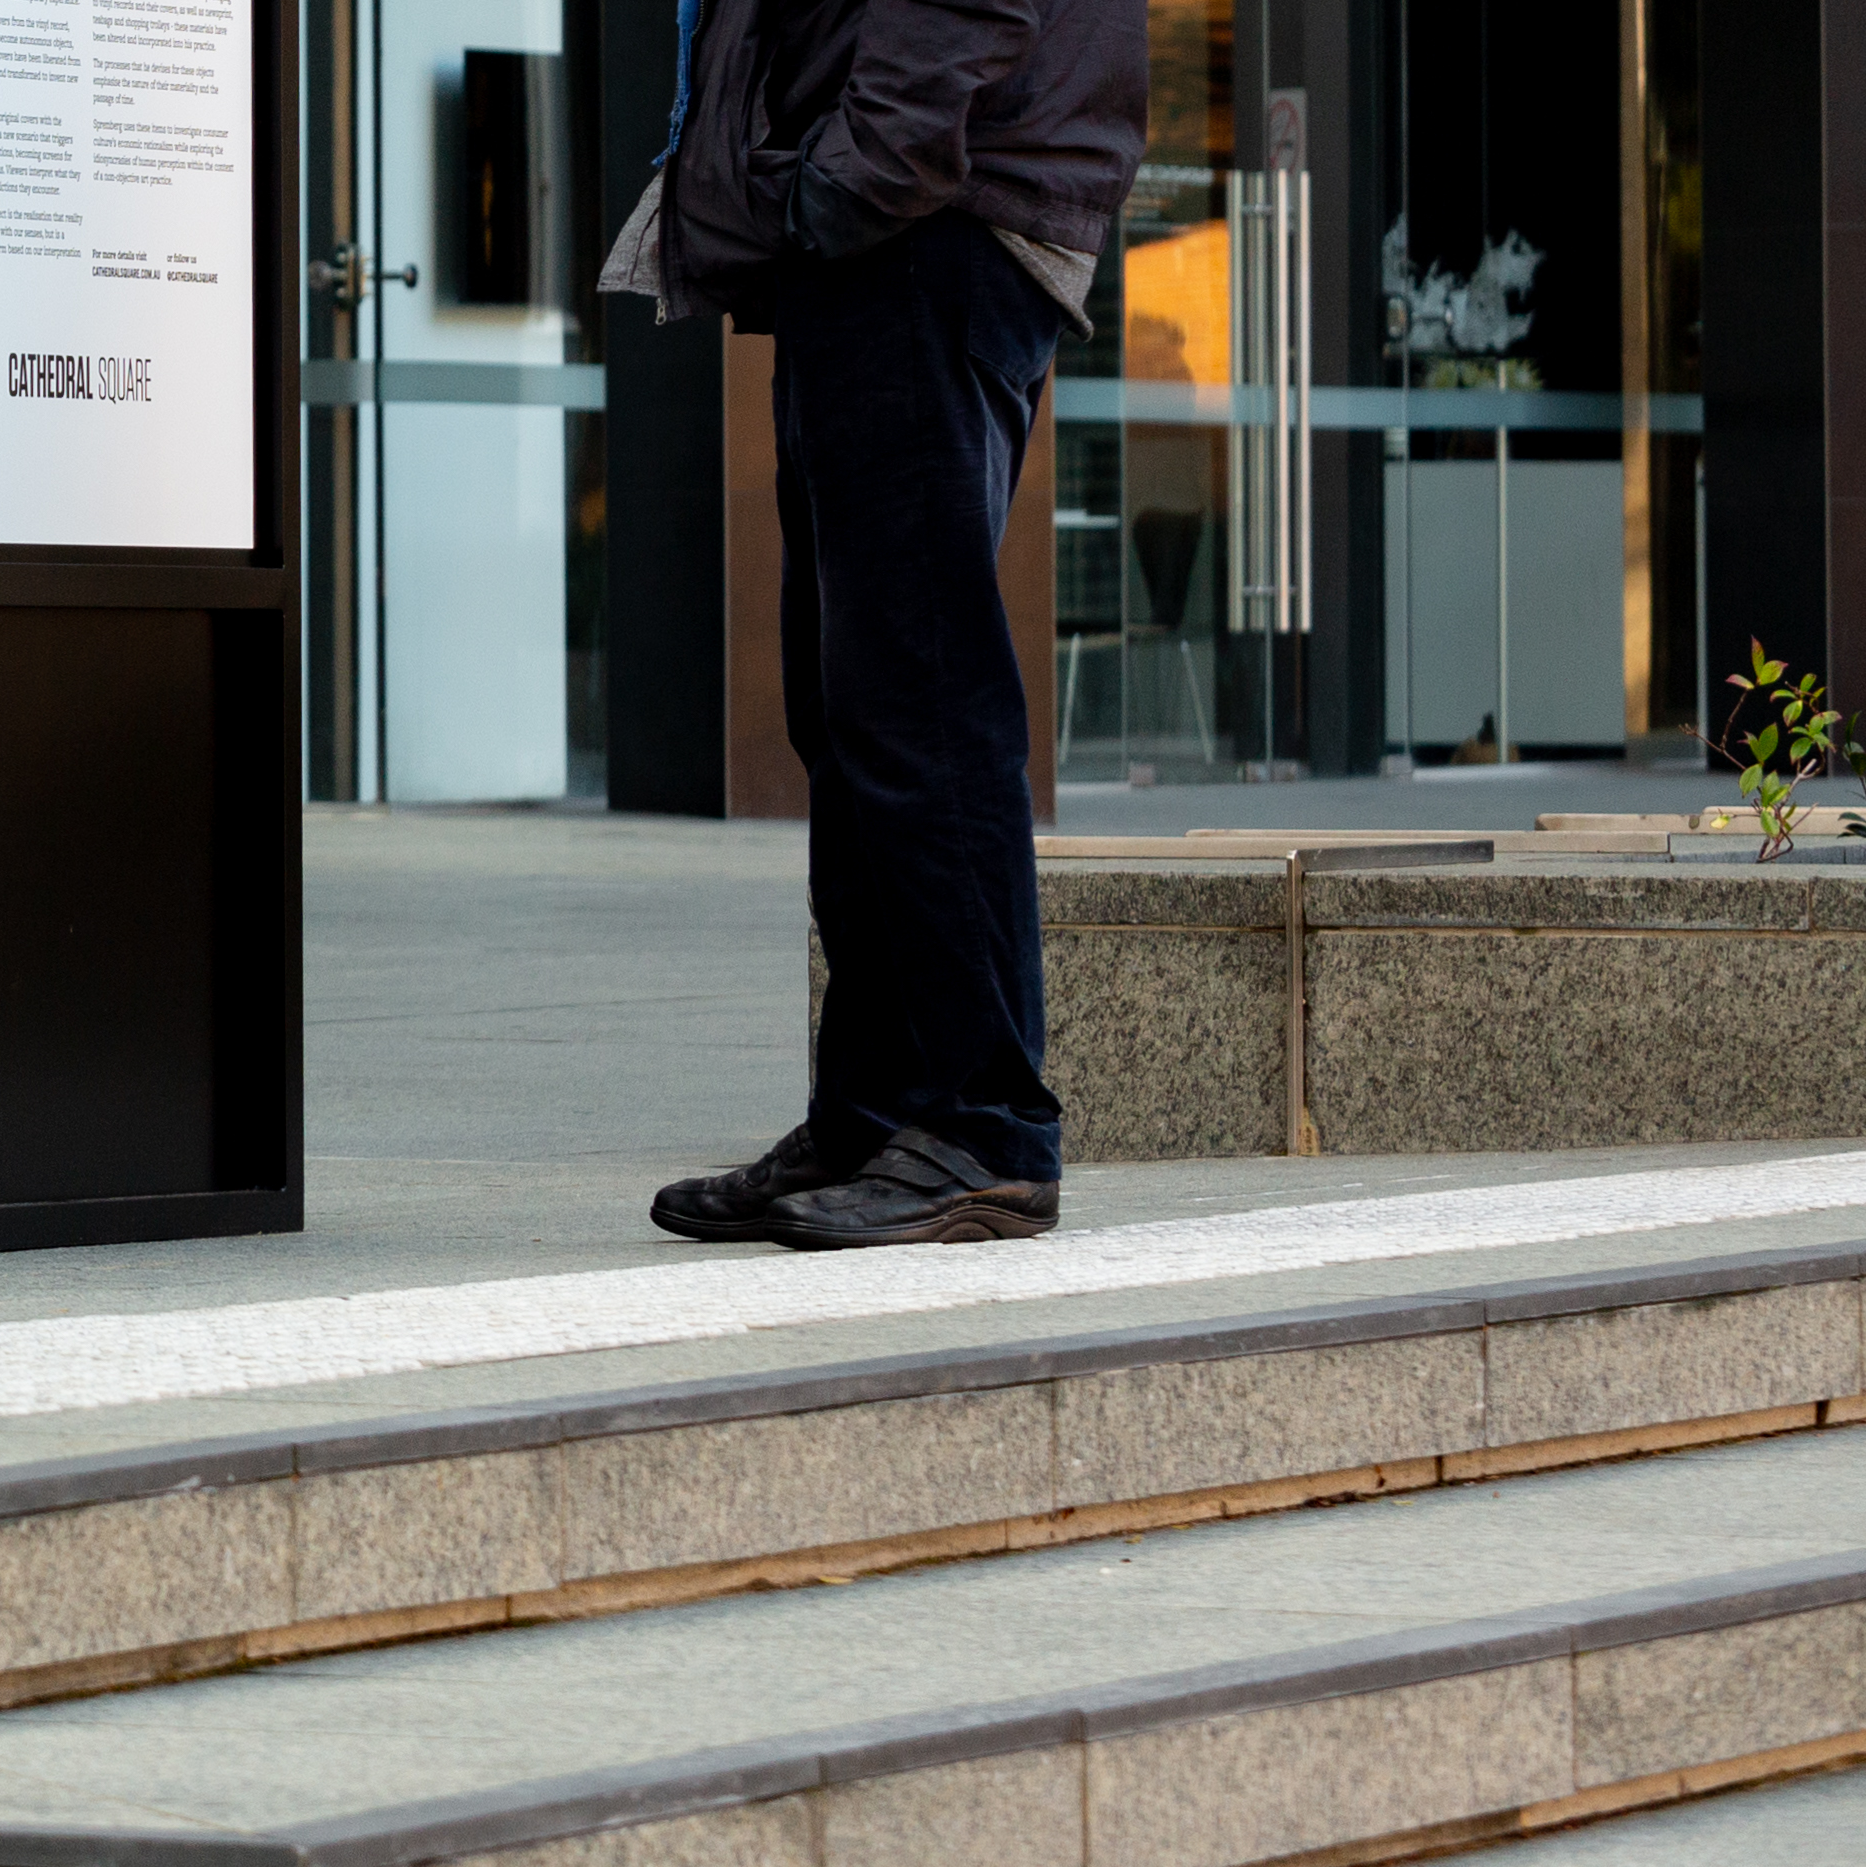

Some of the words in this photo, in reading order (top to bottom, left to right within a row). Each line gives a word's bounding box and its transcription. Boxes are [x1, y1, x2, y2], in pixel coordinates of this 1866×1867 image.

[114, 0, 134, 11] records
[146, 2, 159, 13] their
[36, 20, 49, 33] vinyl
[125, 17, 149, 32] shopping
[150, 20, 170, 34] trolleys
[174, 22, 188, 33] these
[189, 24, 214, 35] materials
[19, 35, 52, 48] autonomous
[107, 33, 126, 45] altered
[138, 36, 172, 50] incorporated
[42, 54, 67, 66] liberated
[7, 69, 41, 81] transformed
[49, 72, 66, 83] invent
[104, 61, 131, 72] processes
[151, 63, 171, 75] devises
[180, 65, 195, 77] these
[195, 67, 215, 80] objects
[93, 76, 121, 89] emphasise
[131, 79, 149, 90] nature
[156, 80, 169, 92] their
[170, 82, 199, 97] materiality
[93, 95, 114, 107] passage
[20, 116, 39, 125] covers
[93, 119, 123, 134] Spremberg
[136, 122, 151, 134] these
[151, 124, 166, 135] items
[173, 126, 202, 140] investigate
[203, 130, 228, 140] consumer
[16, 132, 39, 143] scenario
[52, 134, 73, 148] triggers
[93, 136, 116, 148] culture's
[118, 140, 142, 150] economic
[144, 141, 173, 153] rationalism
[174, 142, 188, 154] while
[190, 144, 214, 158] exploring
[15, 148, 41, 163] becoming
[42, 152, 63, 162] screens
[138, 156, 156, 168] human
[158, 160, 186, 172] perception
[187, 161, 204, 172] within
[214, 163, 234, 174] context
[6, 165, 28, 177] Viewers
[29, 167, 53, 181] interpret
[23, 211, 52, 223] realisation
[65, 213, 83, 227] reality
[8, 244, 24, 256] based
[92, 248, 101, 259] For
[103, 251, 116, 260] more
[117, 250, 135, 261] details
[136, 251, 147, 261] visit
[166, 255, 173, 263] or
[174, 253, 189, 263] follow
[190, 256, 197, 264] us
[92, 266, 161, 280] CATHEDRALSQUARE.COM.AU
[167, 271, 218, 284] @CATHEDRALSQUARE
[8, 352, 93, 399] CATHEDRAL
[98, 357, 152, 404] SQUARE
